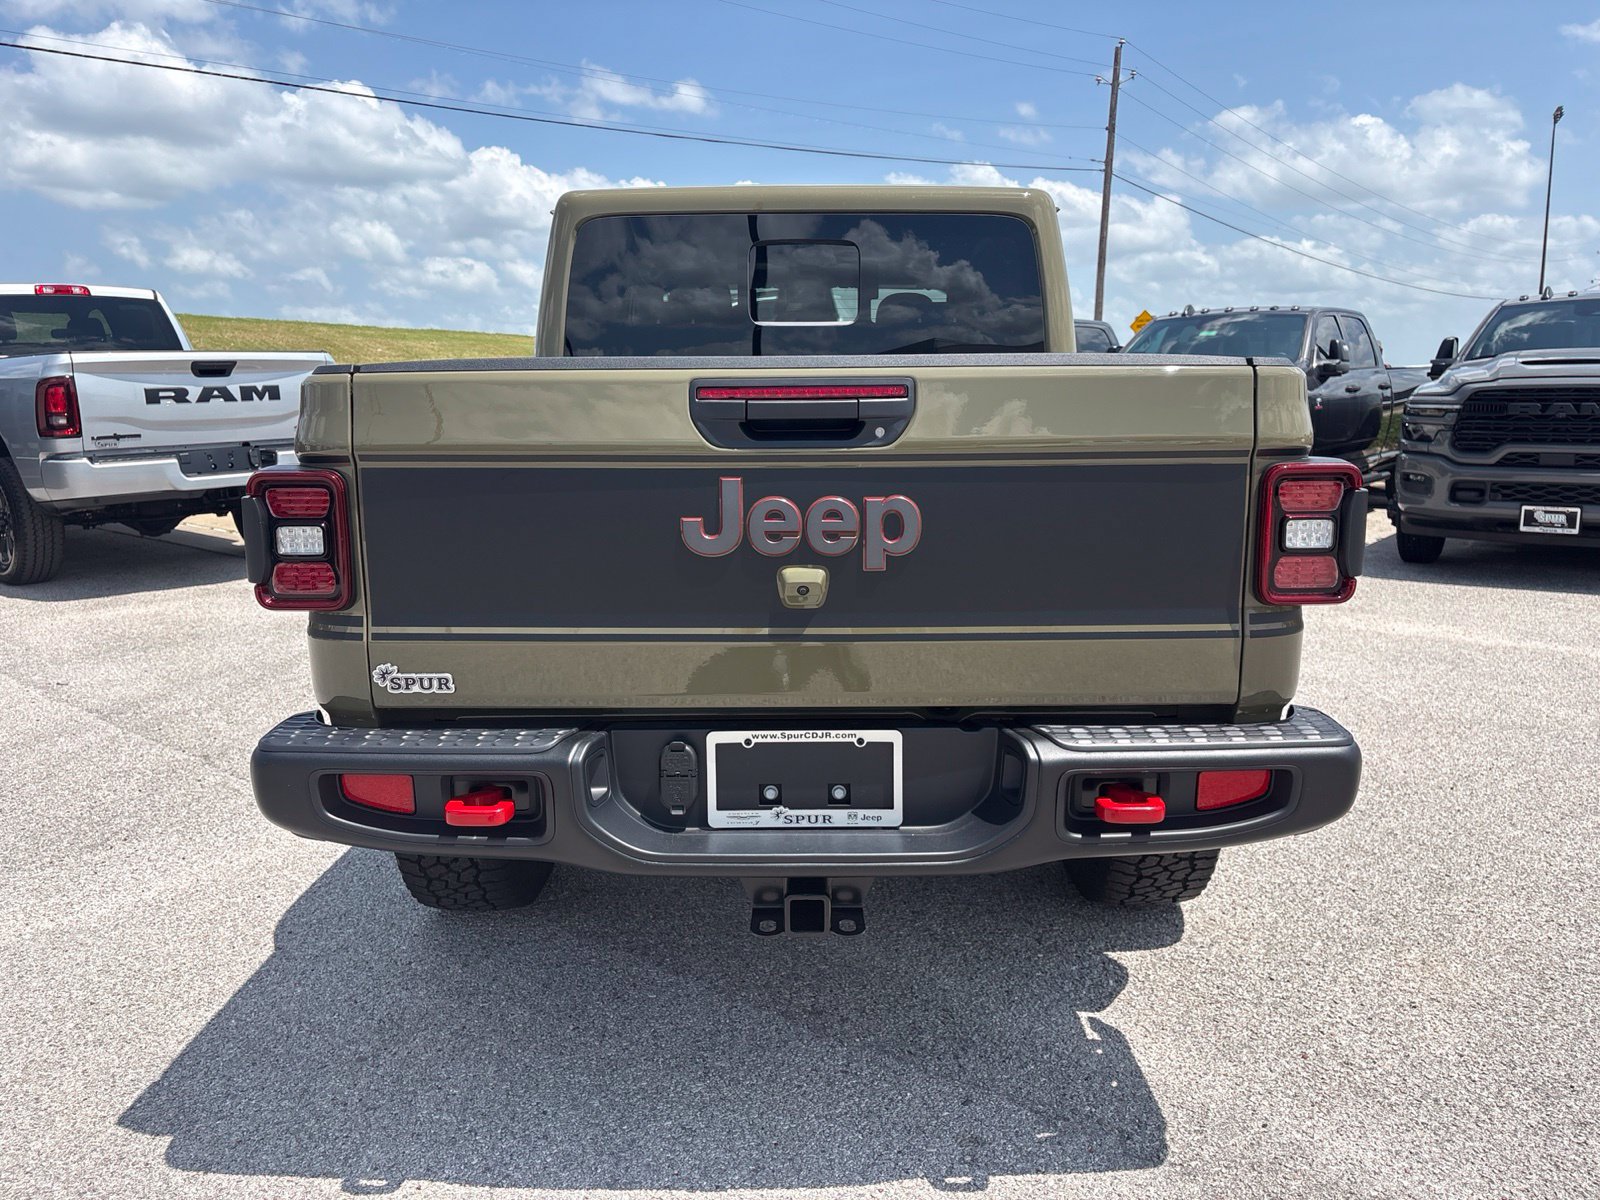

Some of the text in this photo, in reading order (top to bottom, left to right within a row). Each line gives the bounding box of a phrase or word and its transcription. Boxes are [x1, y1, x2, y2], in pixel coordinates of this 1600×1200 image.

[143, 384, 281, 405] RAM
[680, 476, 922, 572] Jeep
[389, 677, 451, 690] SPUR
[751, 731, 857, 741] www.SpurCDJR.com
[783, 814, 833, 825] SPUR
[860, 813, 882, 822] Jeep
